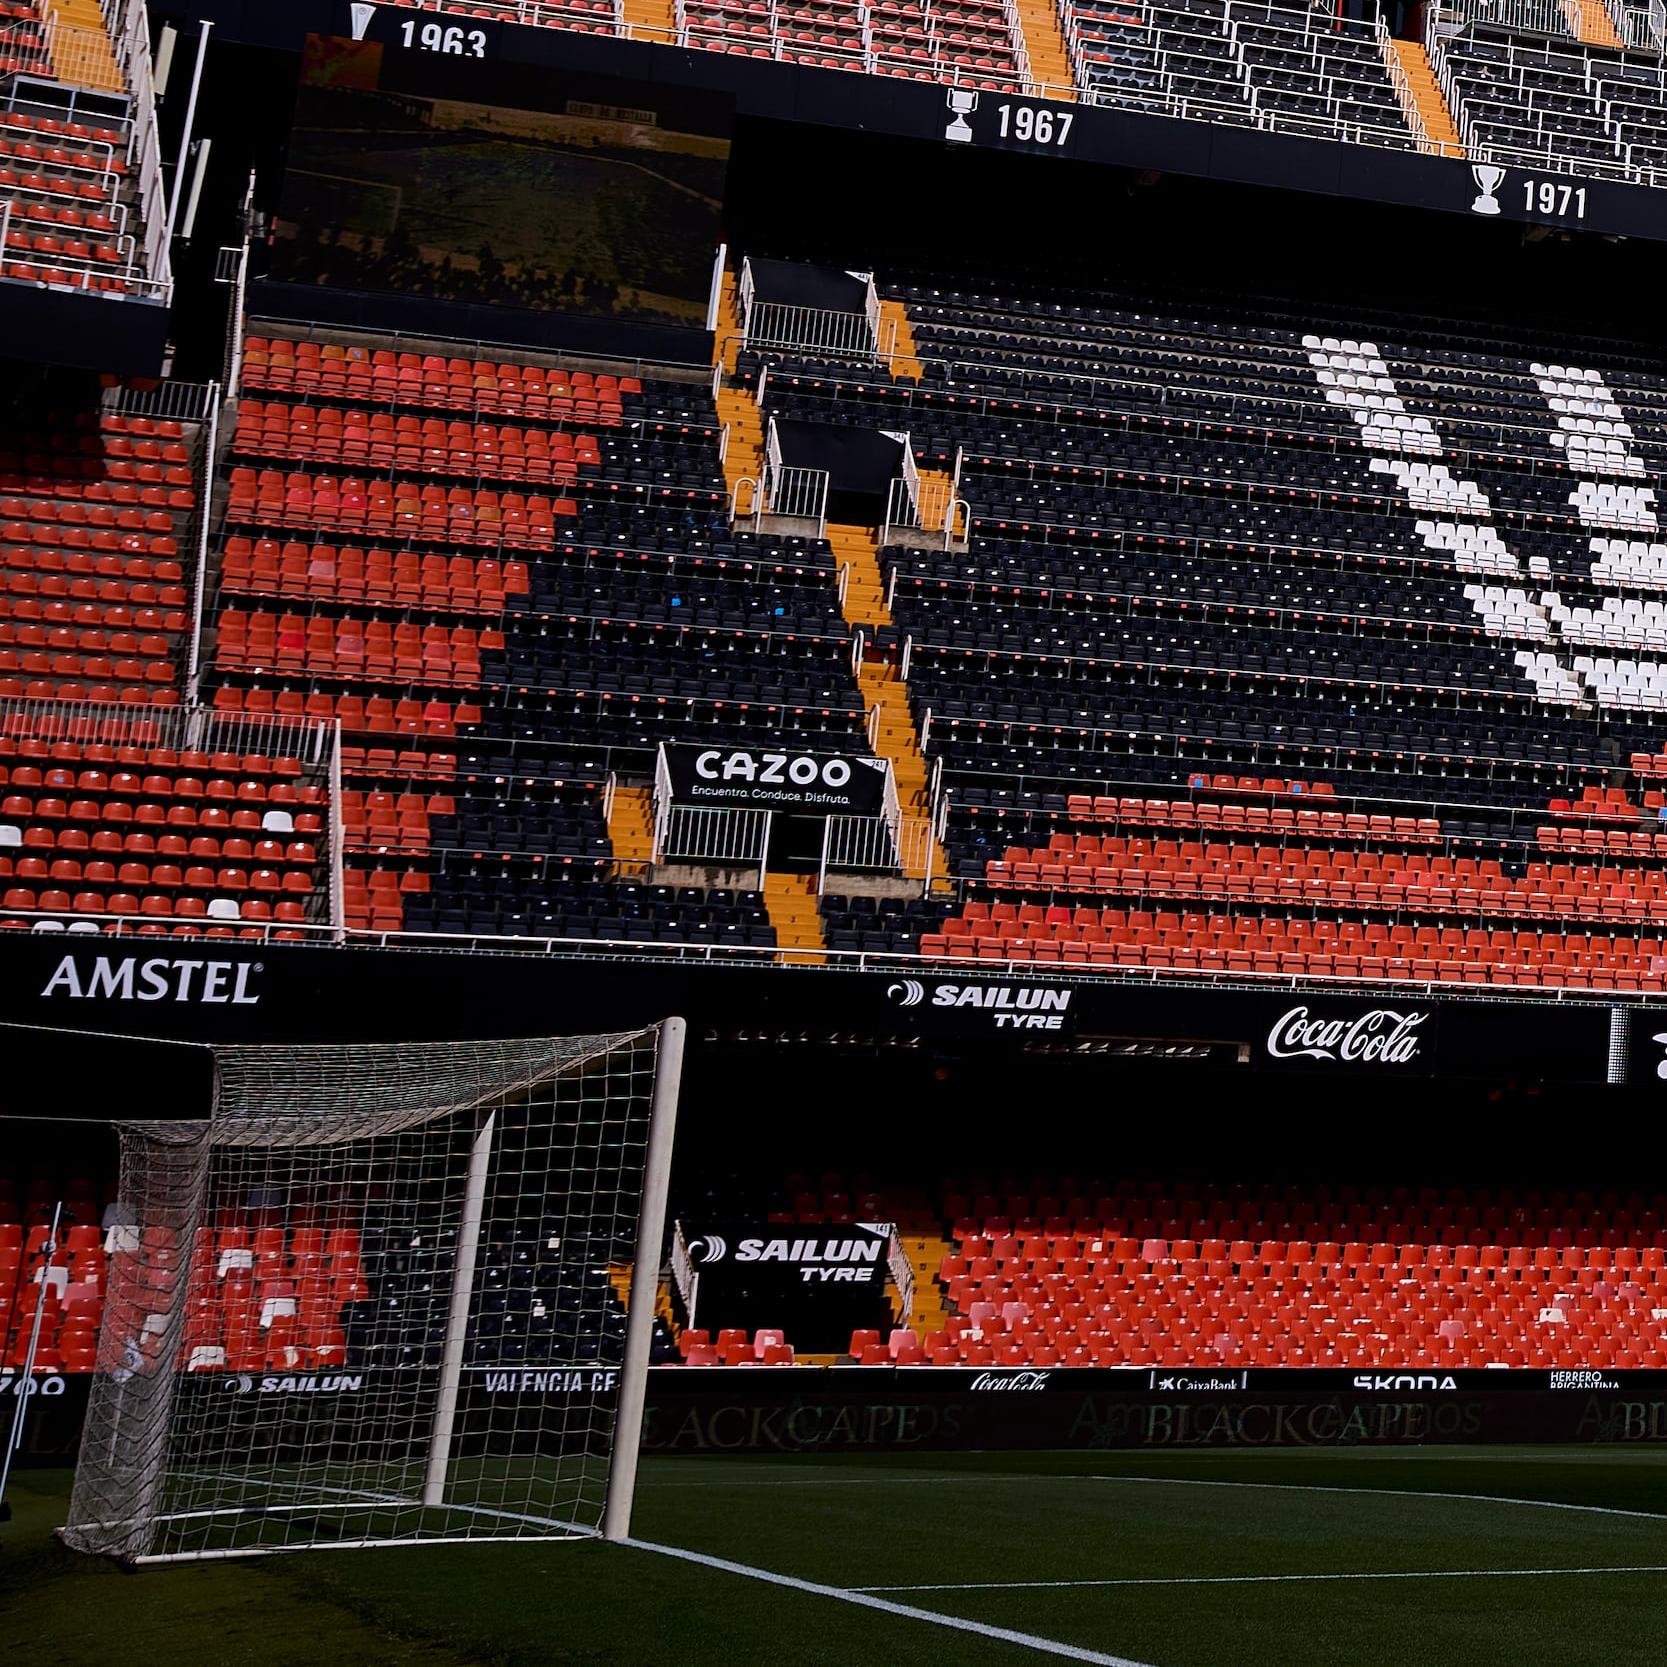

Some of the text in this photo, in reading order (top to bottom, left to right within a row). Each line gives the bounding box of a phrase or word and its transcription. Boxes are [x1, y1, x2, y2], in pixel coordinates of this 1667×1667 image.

[401, 20, 487, 58] 1963
[998, 104, 1074, 146] 1967
[1523, 180, 1586, 219] 1971
[695, 750, 851, 787] CAZOO
[691, 785, 850, 805] Encuentra. Conduce. Disfruta.
[41, 954, 261, 1004] AMSTEL
[931, 985, 1072, 1010] SAILUN
[993, 1014, 1065, 1029] TYRE
[1267, 1006, 1429, 1063] Coca-Cola
[735, 1239, 882, 1263] SAILUN
[800, 1267, 874, 1283] TYRE
[259, 1376, 363, 1394] SAILUN
[1550, 1371, 1602, 1382] HERRERO
